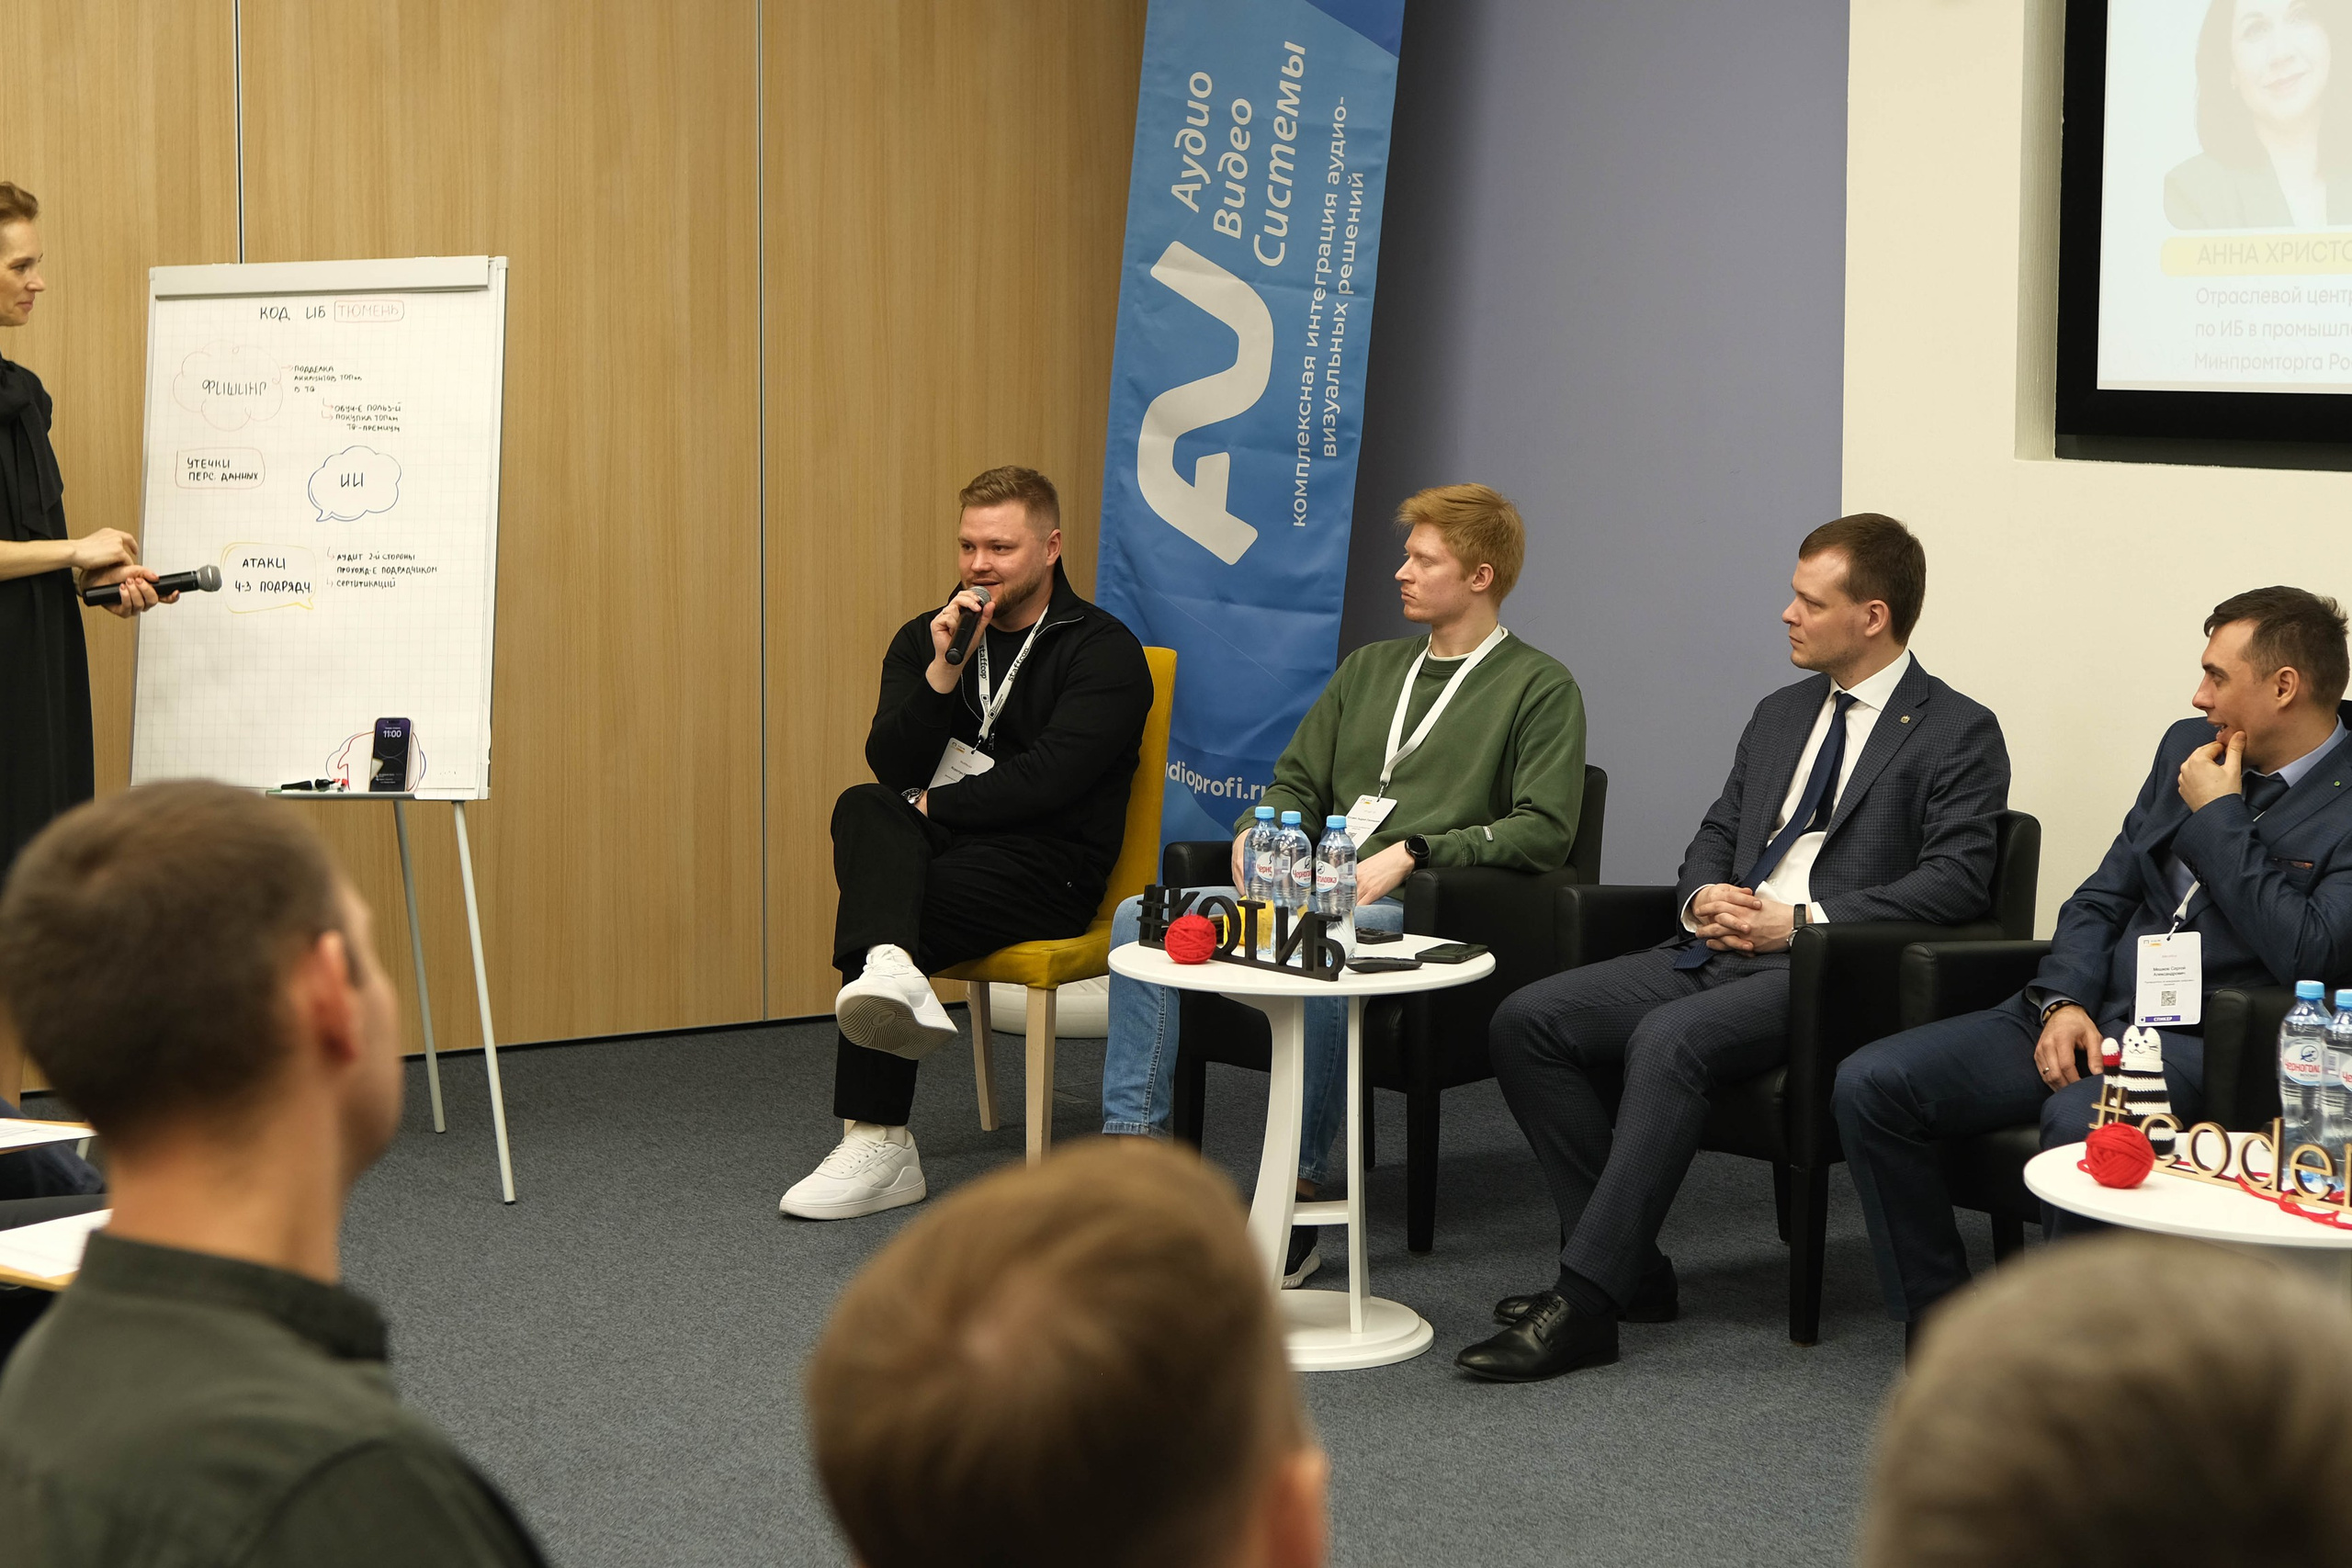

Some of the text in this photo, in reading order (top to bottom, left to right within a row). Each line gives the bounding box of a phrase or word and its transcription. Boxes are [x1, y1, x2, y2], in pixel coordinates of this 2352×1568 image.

[1170, 71, 1213, 213] Аудио
[1253, 40, 1306, 266] Системы
[1213, 97, 1253, 240] Видео
[2197, 243, 2259, 265] АННА
[2196, 287, 2302, 308] Отраслевой
[260, 304, 399, 322] КОД ИБ ТЮМЕНЬ
[1293, 96, 1347, 527] комплексная интеграция аудио-
[1323, 172, 1364, 457] визуальных решений
[2195, 320, 2352, 341] по ИБ в промышл
[294, 365, 334, 373] ПОДДЕЛКА
[2194, 352, 2323, 373] Минпромторга
[202, 378, 266, 396] ФИШИНГ
[335, 413, 371, 422] ПОКУПКА
[187, 457, 231, 468] УТЕЧКИ
[220, 471, 259, 482] ДАННЫХ
[340, 472, 364, 488] ИИ
[243, 558, 286, 570] АТАКИ
[336, 553, 363, 561] АУДИТ
[382, 553, 415, 561] СТОРОНЫ
[978, 644, 988, 680] staffcop
[1008, 647, 1029, 682] staffcop
[383, 729, 401, 739] 11:00
[1164, 761, 1266, 800] dioprofi.r
